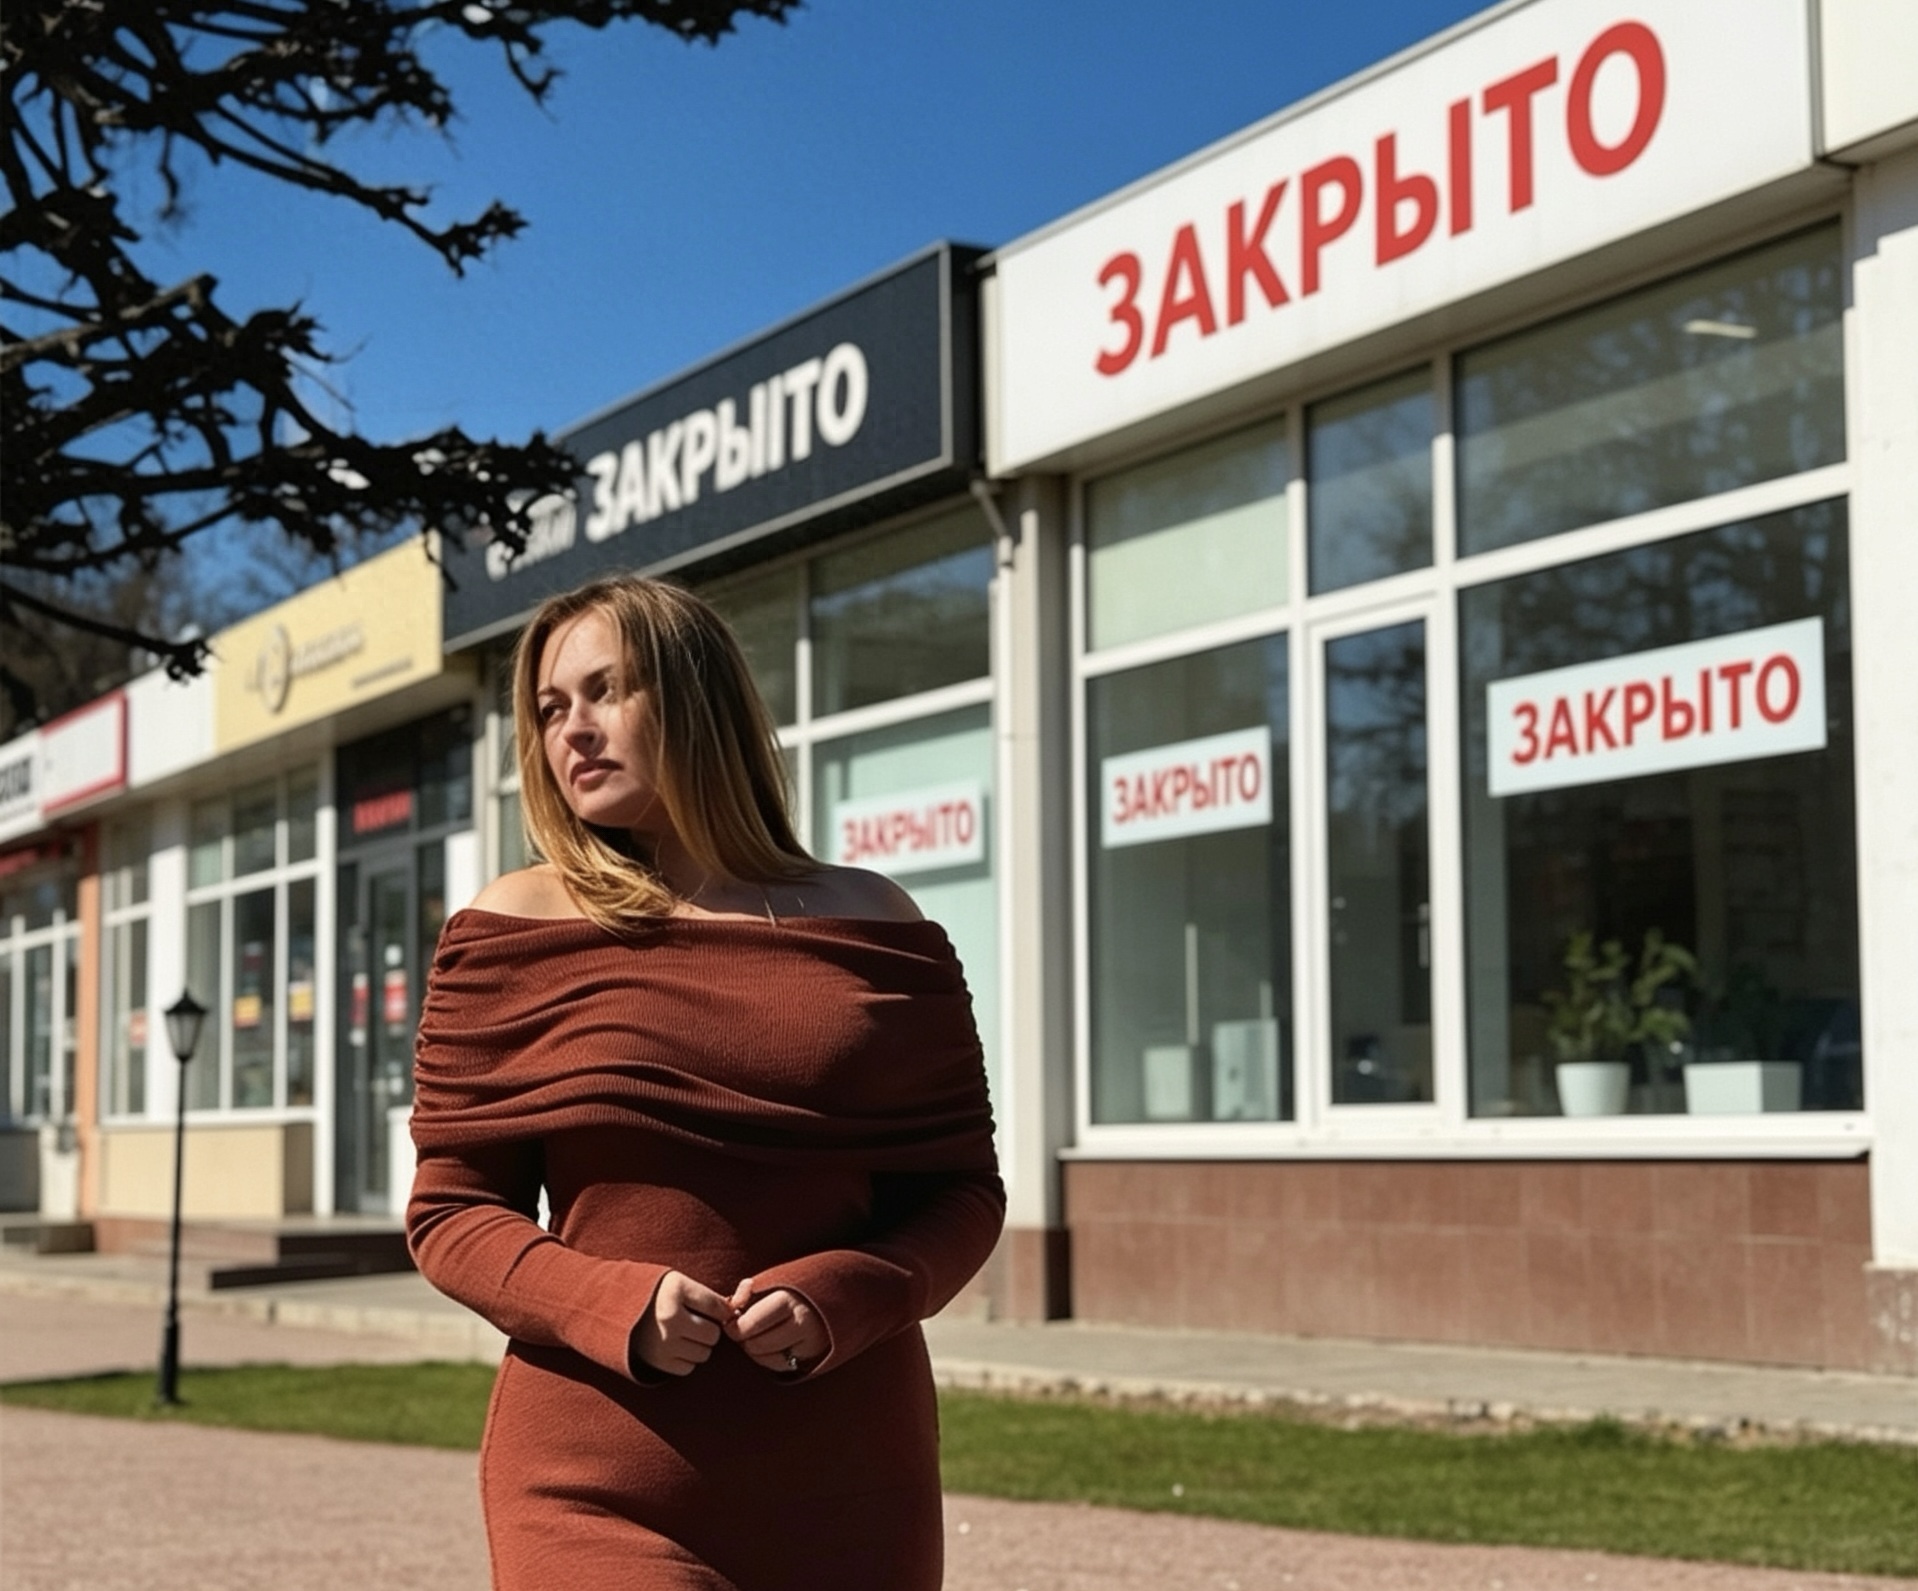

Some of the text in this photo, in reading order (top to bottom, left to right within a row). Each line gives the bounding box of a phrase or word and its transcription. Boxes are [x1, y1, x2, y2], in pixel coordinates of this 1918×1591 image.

[1095, 19, 1666, 377] ЗАКРЫТО
[1512, 654, 1801, 765] ЗАКРЫТО
[842, 800, 975, 863] ЗАКРЫТО
[1113, 752, 1261, 824] ЗАКРЫТО
